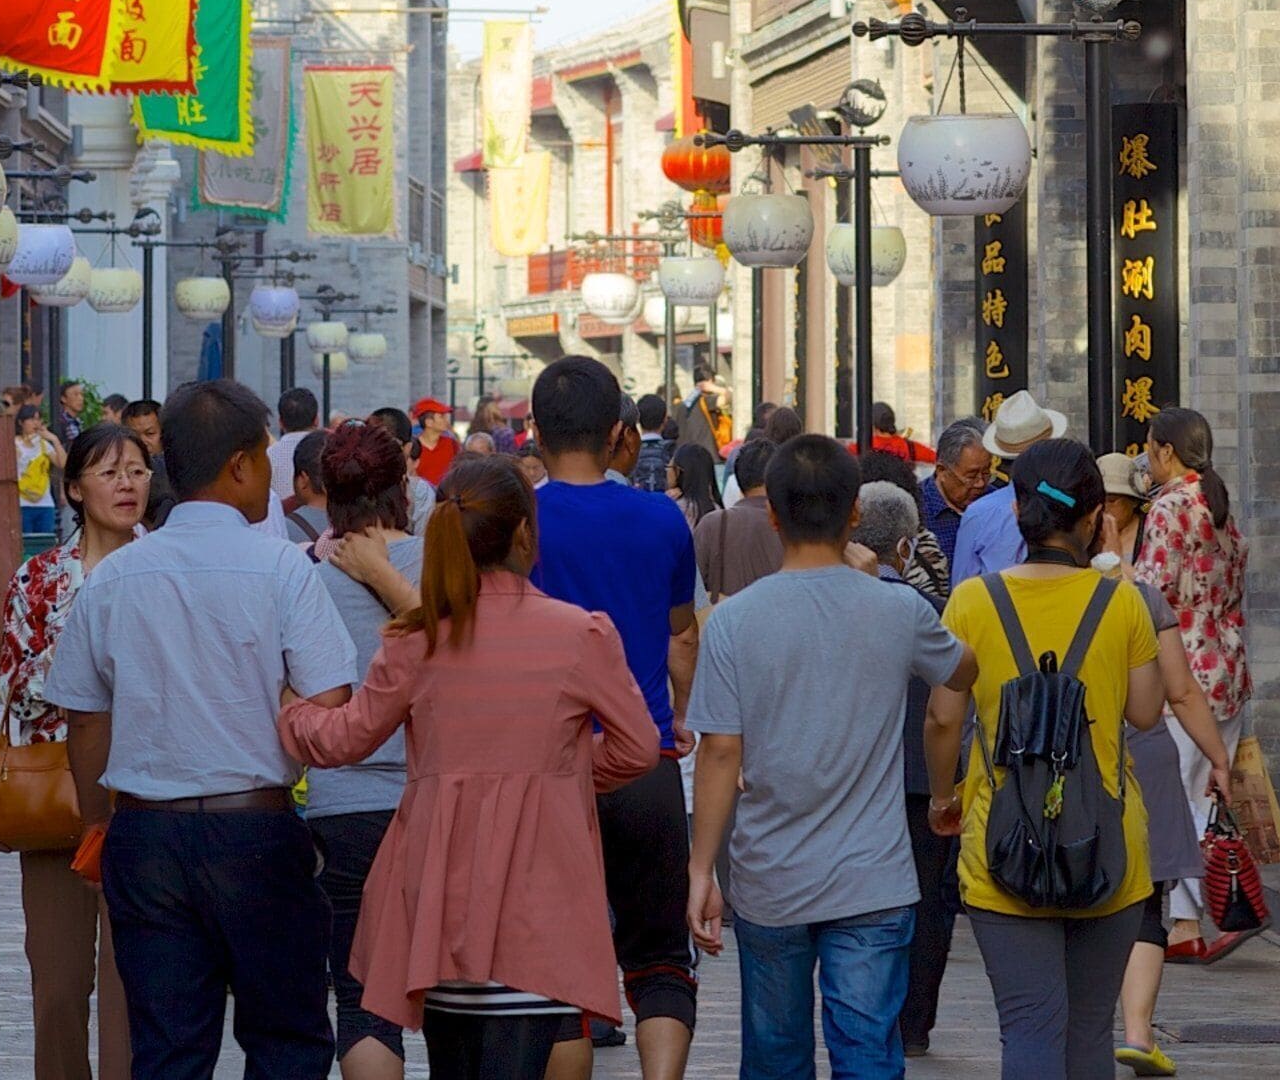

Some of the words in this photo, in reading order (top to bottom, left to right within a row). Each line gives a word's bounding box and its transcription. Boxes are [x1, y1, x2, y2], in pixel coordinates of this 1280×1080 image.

[347, 81, 383, 176] 天兴居
[982, 213, 1010, 424] 品特色
[1119, 133, 1160, 457] 爆肚涮肉爆
